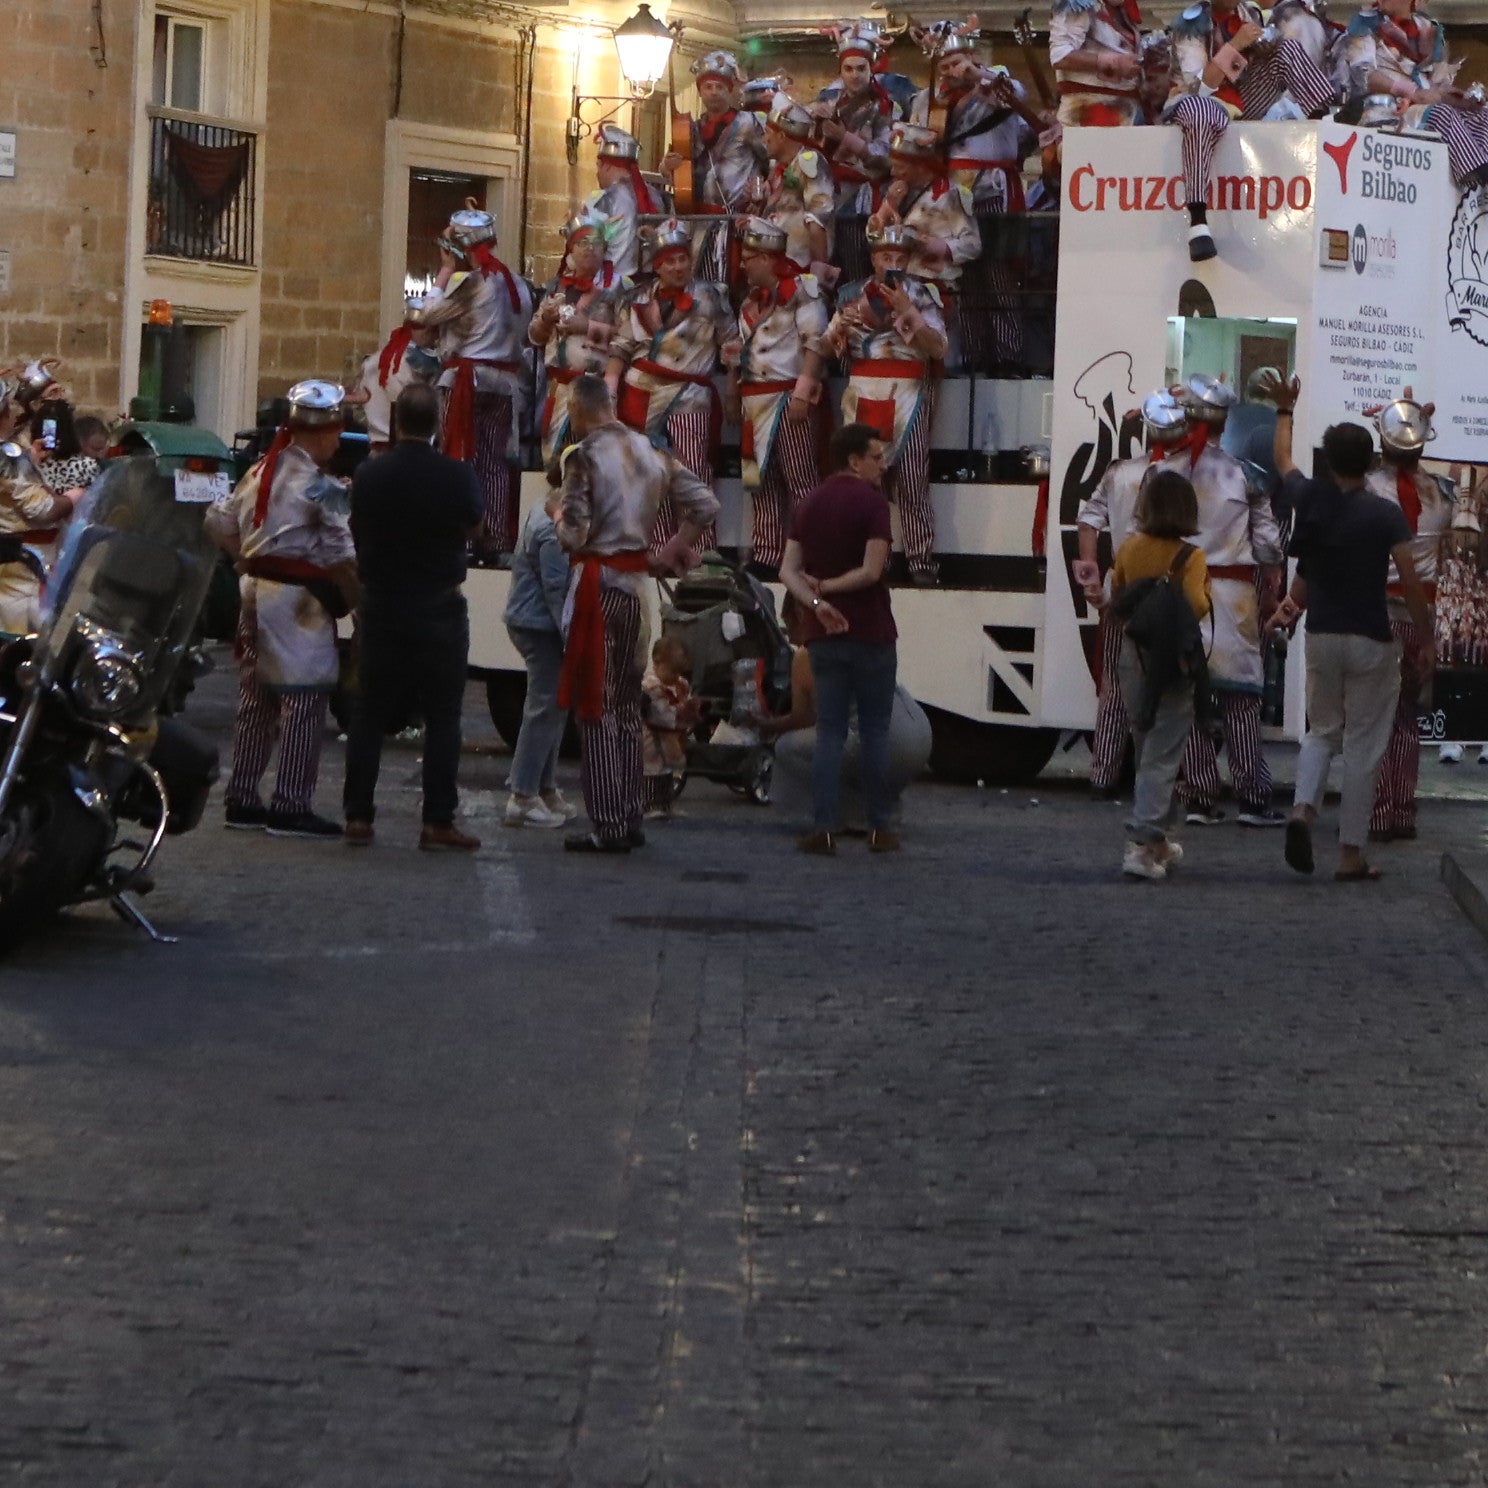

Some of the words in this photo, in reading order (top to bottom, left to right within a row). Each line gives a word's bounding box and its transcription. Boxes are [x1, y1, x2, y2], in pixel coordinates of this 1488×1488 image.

[1362, 133, 1432, 172] Seguros
[1068, 162, 1313, 220] Cruzcmpo
[1361, 170, 1418, 204] Bilbao
[1370, 226, 1397, 259] morilla
[1358, 304, 1388, 318] AGENCIA
[1318, 317, 1346, 331] MANUEL
[1347, 320, 1376, 333] MORILLA
[1377, 323, 1411, 338] ASESORES
[1330, 334, 1360, 349] SEGUROS
[1361, 338, 1387, 351] BILBAO
[1384, 374, 1401, 385] Local
[1353, 386, 1372, 398] 11010
